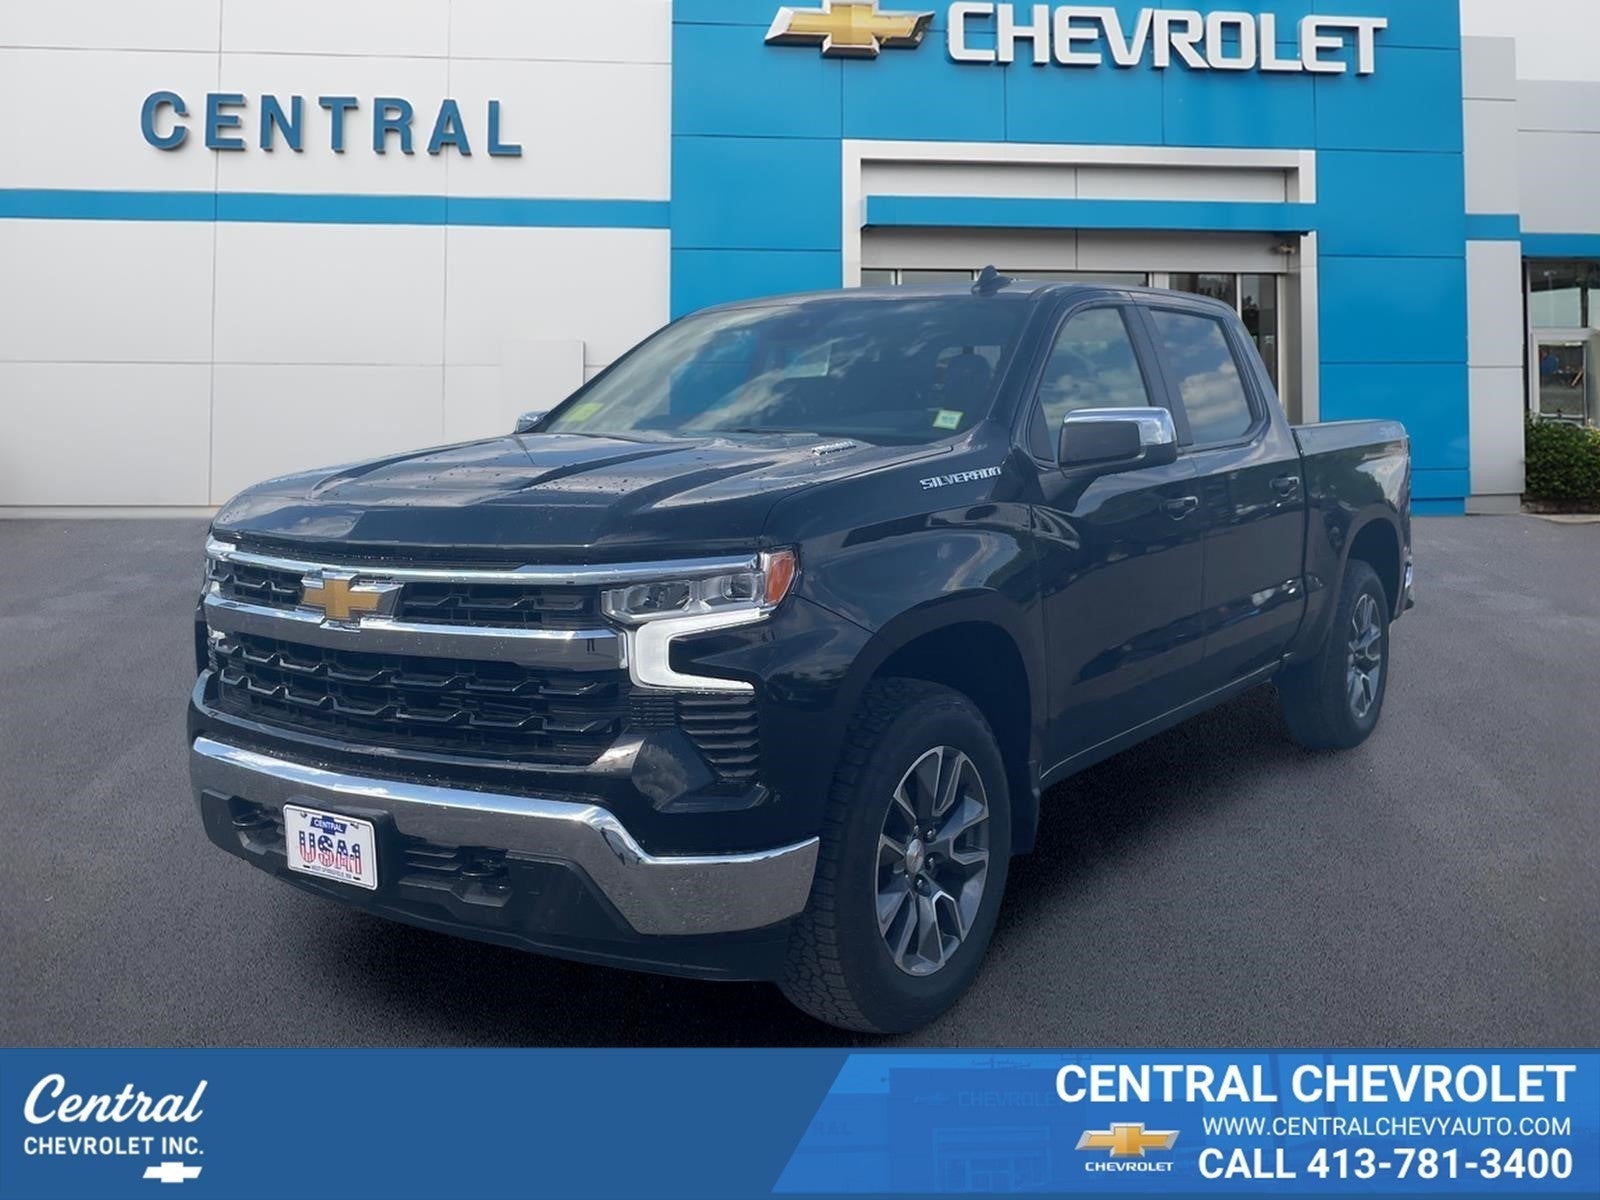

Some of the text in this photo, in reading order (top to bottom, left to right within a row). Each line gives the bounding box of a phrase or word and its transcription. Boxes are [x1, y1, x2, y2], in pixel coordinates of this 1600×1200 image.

[947, 1, 1388, 75] CHEVROLET
[140, 90, 523, 158] CENTRAL
[919, 465, 1002, 490] SILVERADO
[313, 818, 343, 832] CENTRAL
